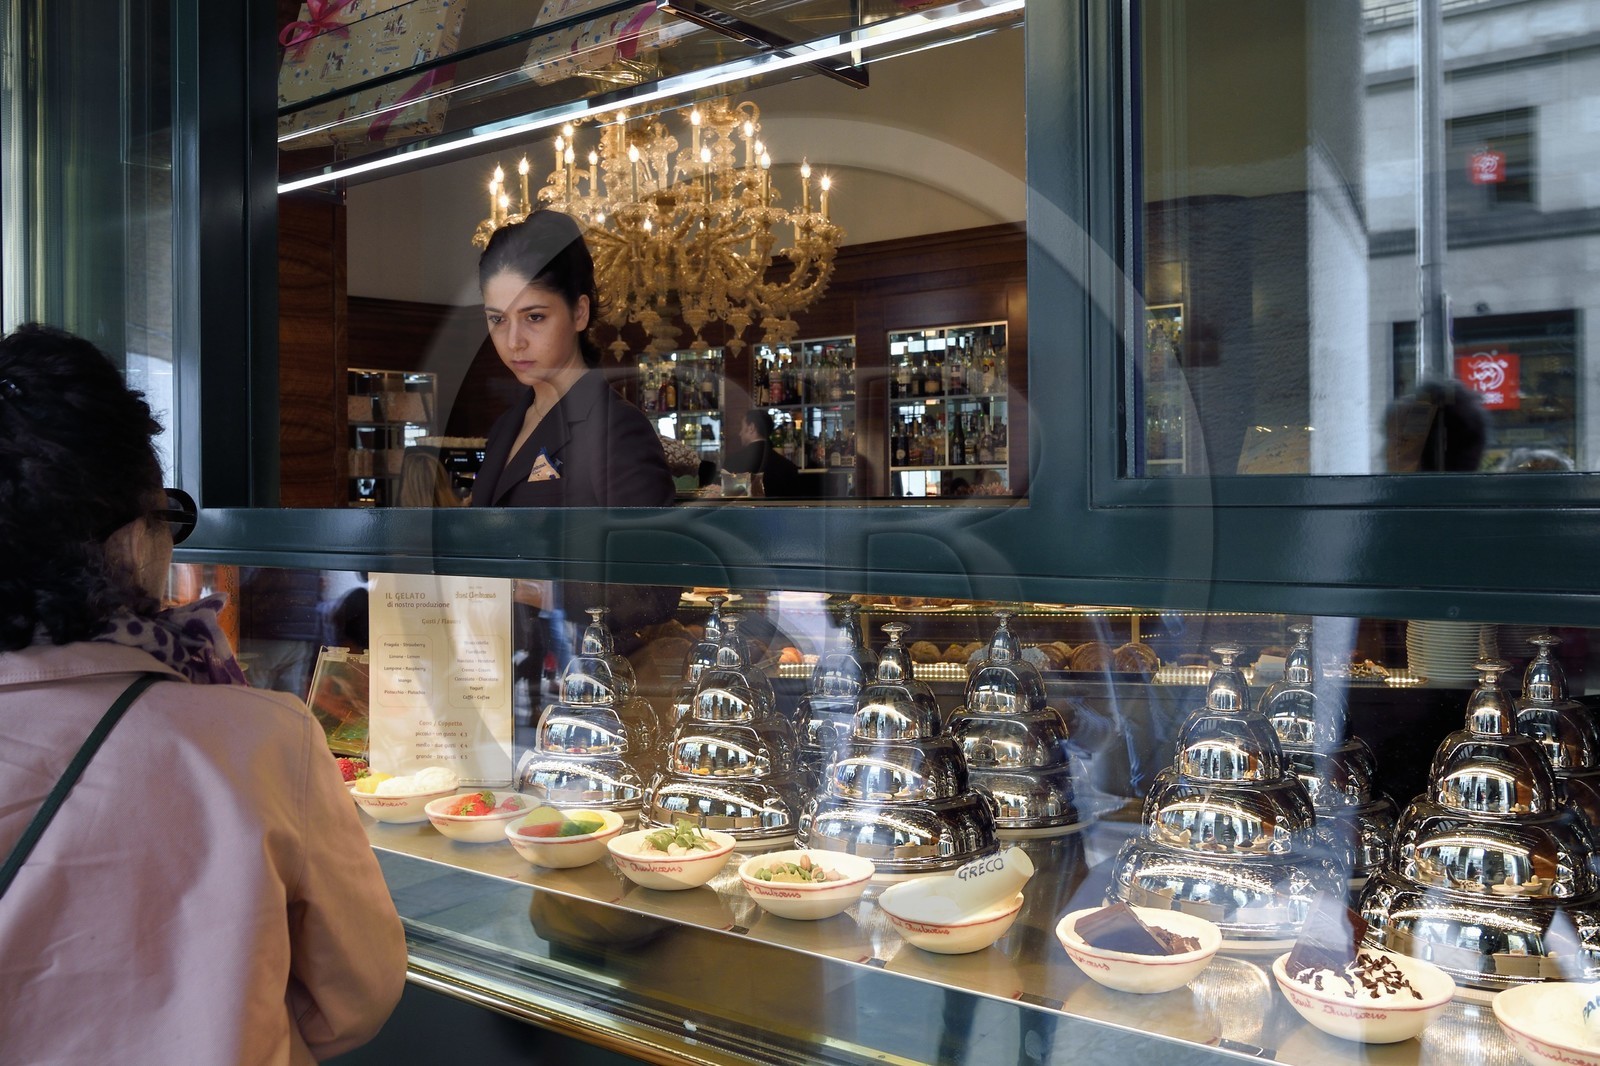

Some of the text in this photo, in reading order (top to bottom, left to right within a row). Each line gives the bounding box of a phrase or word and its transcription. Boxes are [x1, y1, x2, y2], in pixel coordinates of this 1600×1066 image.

[385, 592, 426, 601] IL GELATO
[415, 601, 450, 609] produzione
[957, 857, 1005, 882] GRECO
